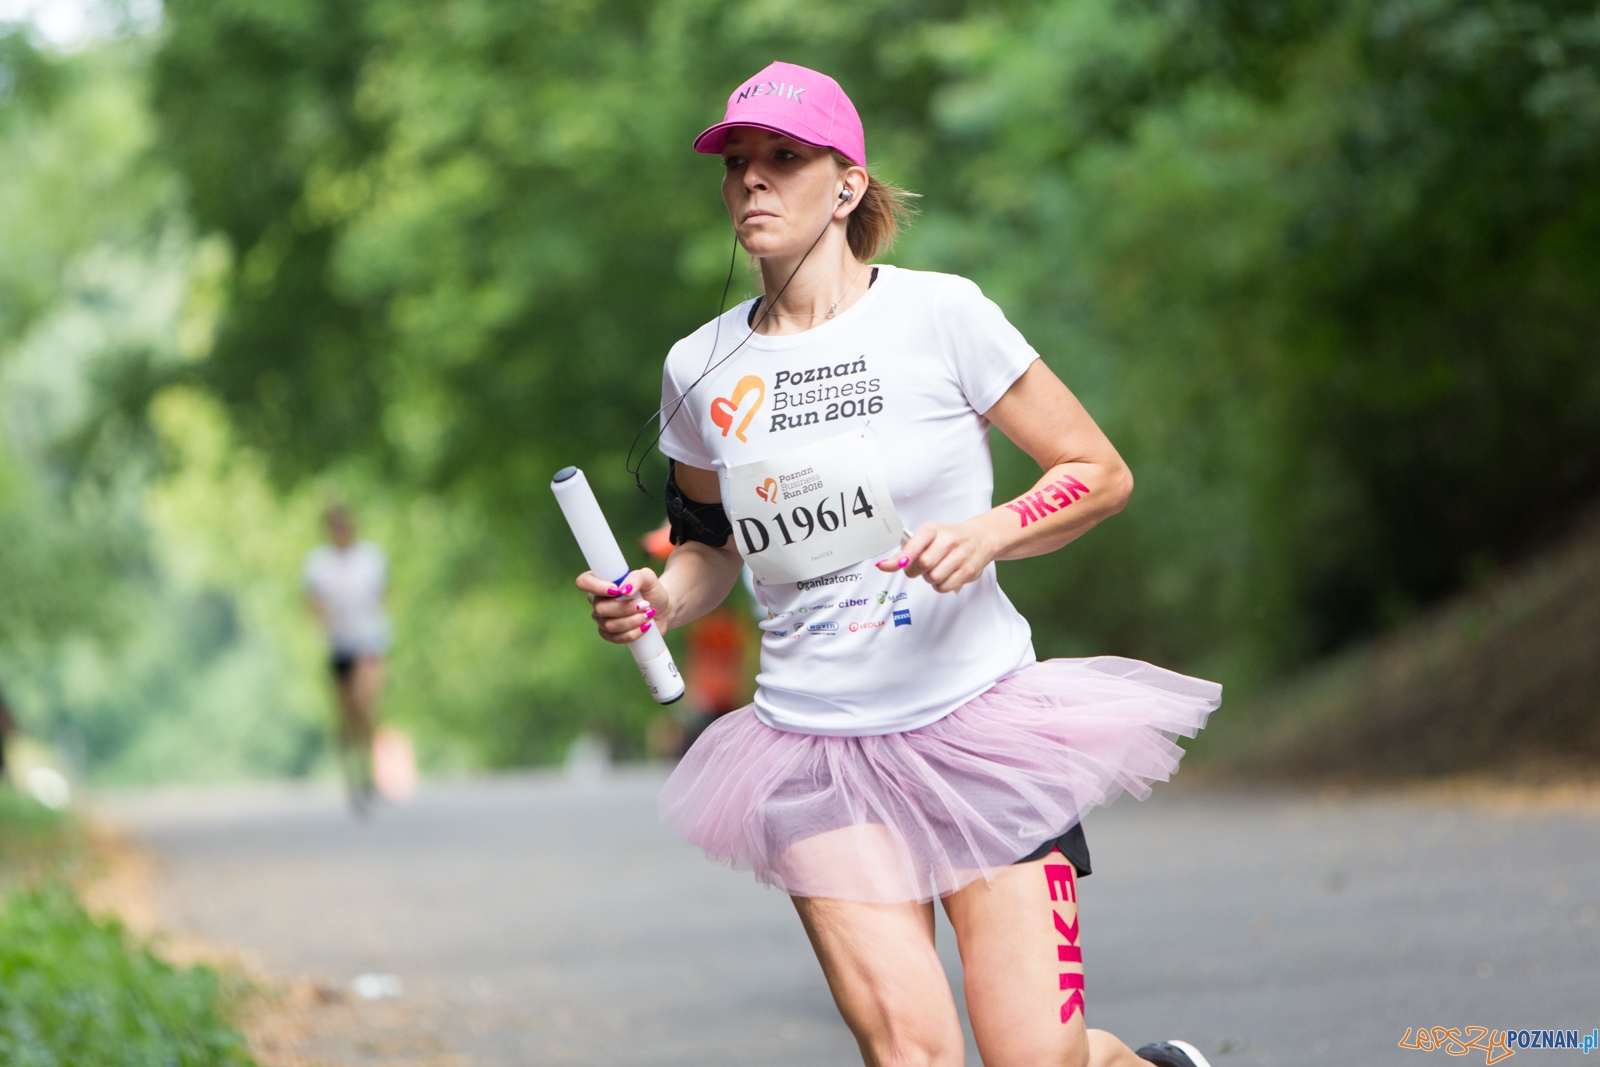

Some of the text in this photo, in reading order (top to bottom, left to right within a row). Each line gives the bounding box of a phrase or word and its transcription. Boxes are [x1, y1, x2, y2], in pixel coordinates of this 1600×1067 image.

[773, 354, 867, 389] Poznań
[771, 378, 881, 411] Business
[769, 395, 884, 433] Run 2016
[780, 474, 821, 492] Business
[783, 480, 824, 500] Run 2016
[797, 572, 862, 591] Oganizatorzy:
[838, 597, 869, 609] ciber
[809, 623, 836, 631] wavin
[859, 620, 886, 630] VEOLIA
[1044, 846, 1086, 1025] EKK
